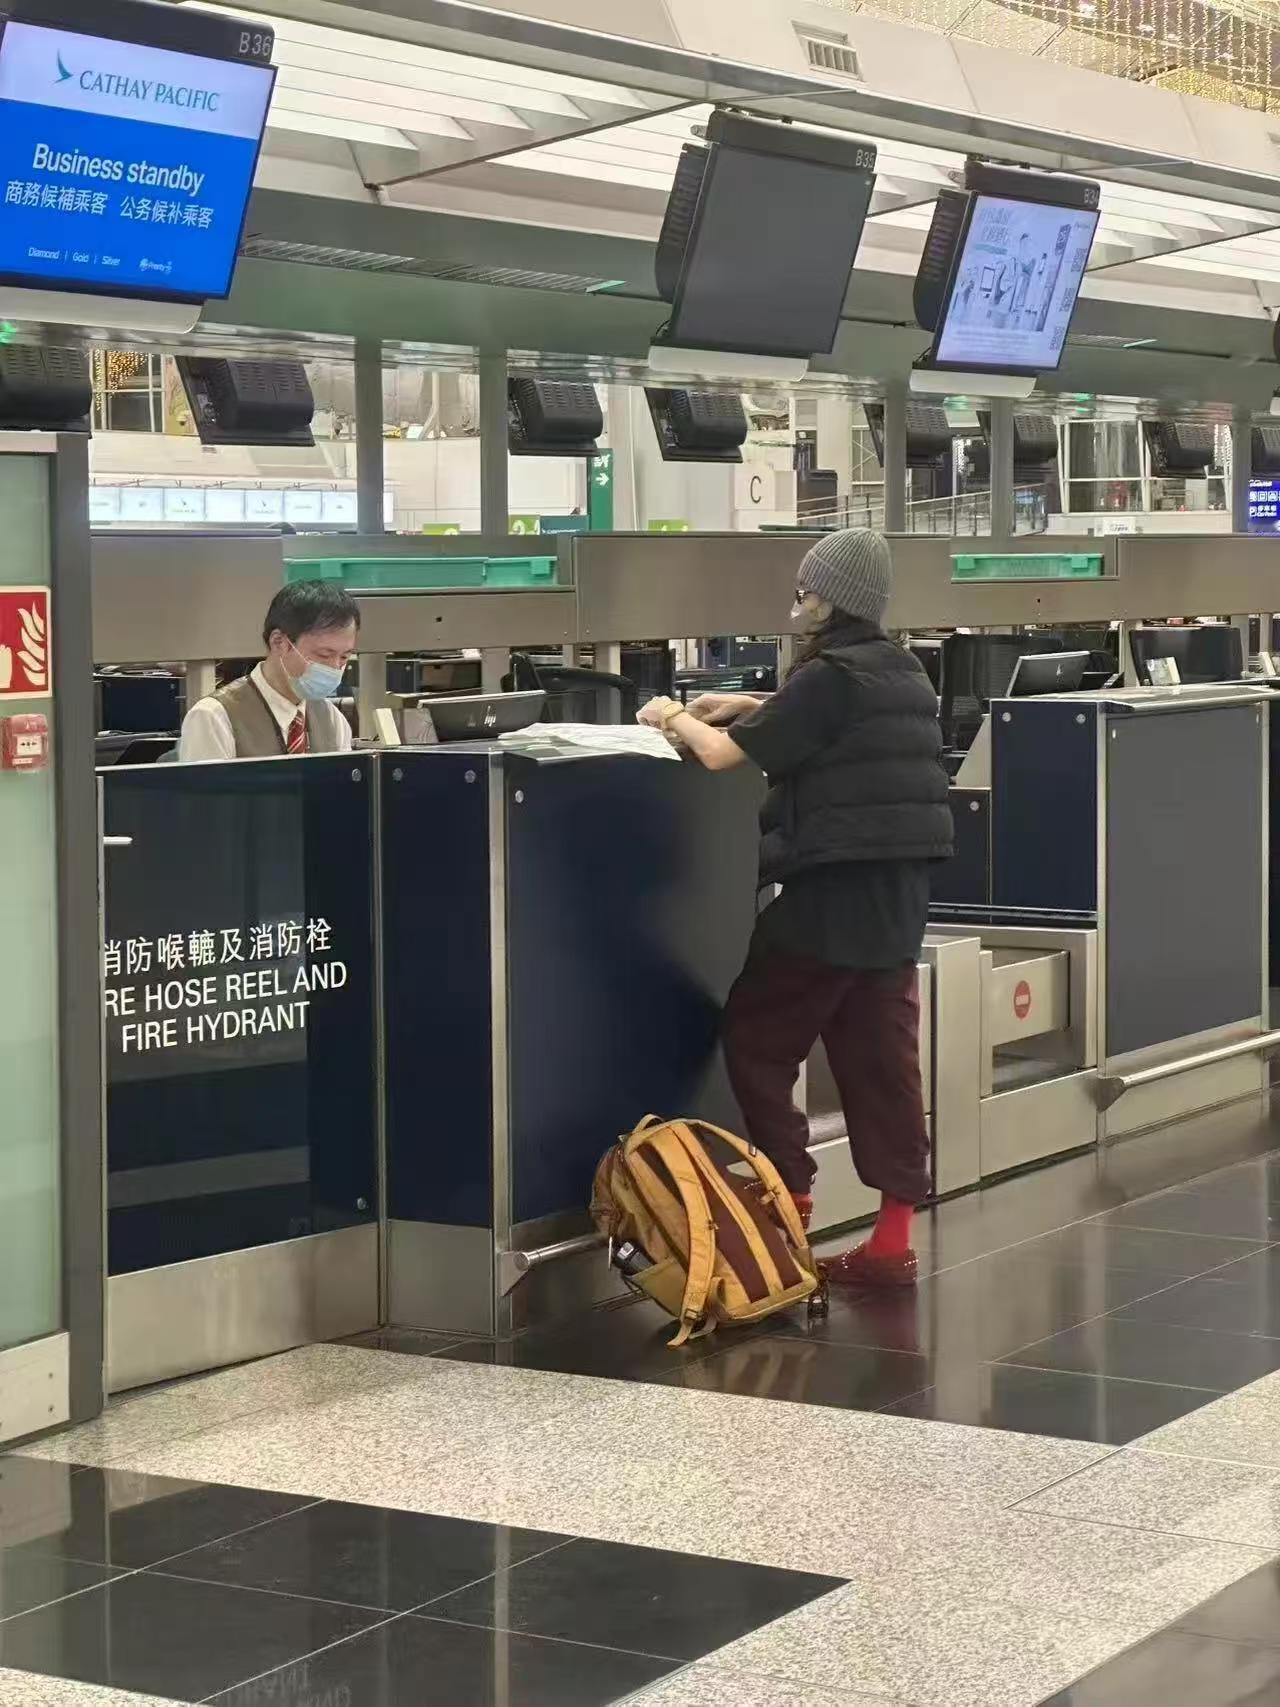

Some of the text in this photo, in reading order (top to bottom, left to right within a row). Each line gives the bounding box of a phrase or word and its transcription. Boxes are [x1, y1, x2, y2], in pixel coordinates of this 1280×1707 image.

[239, 32, 272, 56] B36
[79, 70, 221, 112] CATHAY PACIFIC
[33, 143, 206, 198] Business standby
[119, 195, 215, 230] 公务候补乘客
[28, 247, 61, 260] Diamond
[750, 475, 762, 504] C
[144, 976, 218, 1012] HOSE
[225, 968, 288, 1002] REEL
[292, 961, 348, 994] AND
[121, 1001, 311, 1053] FIRE HYDRANT
